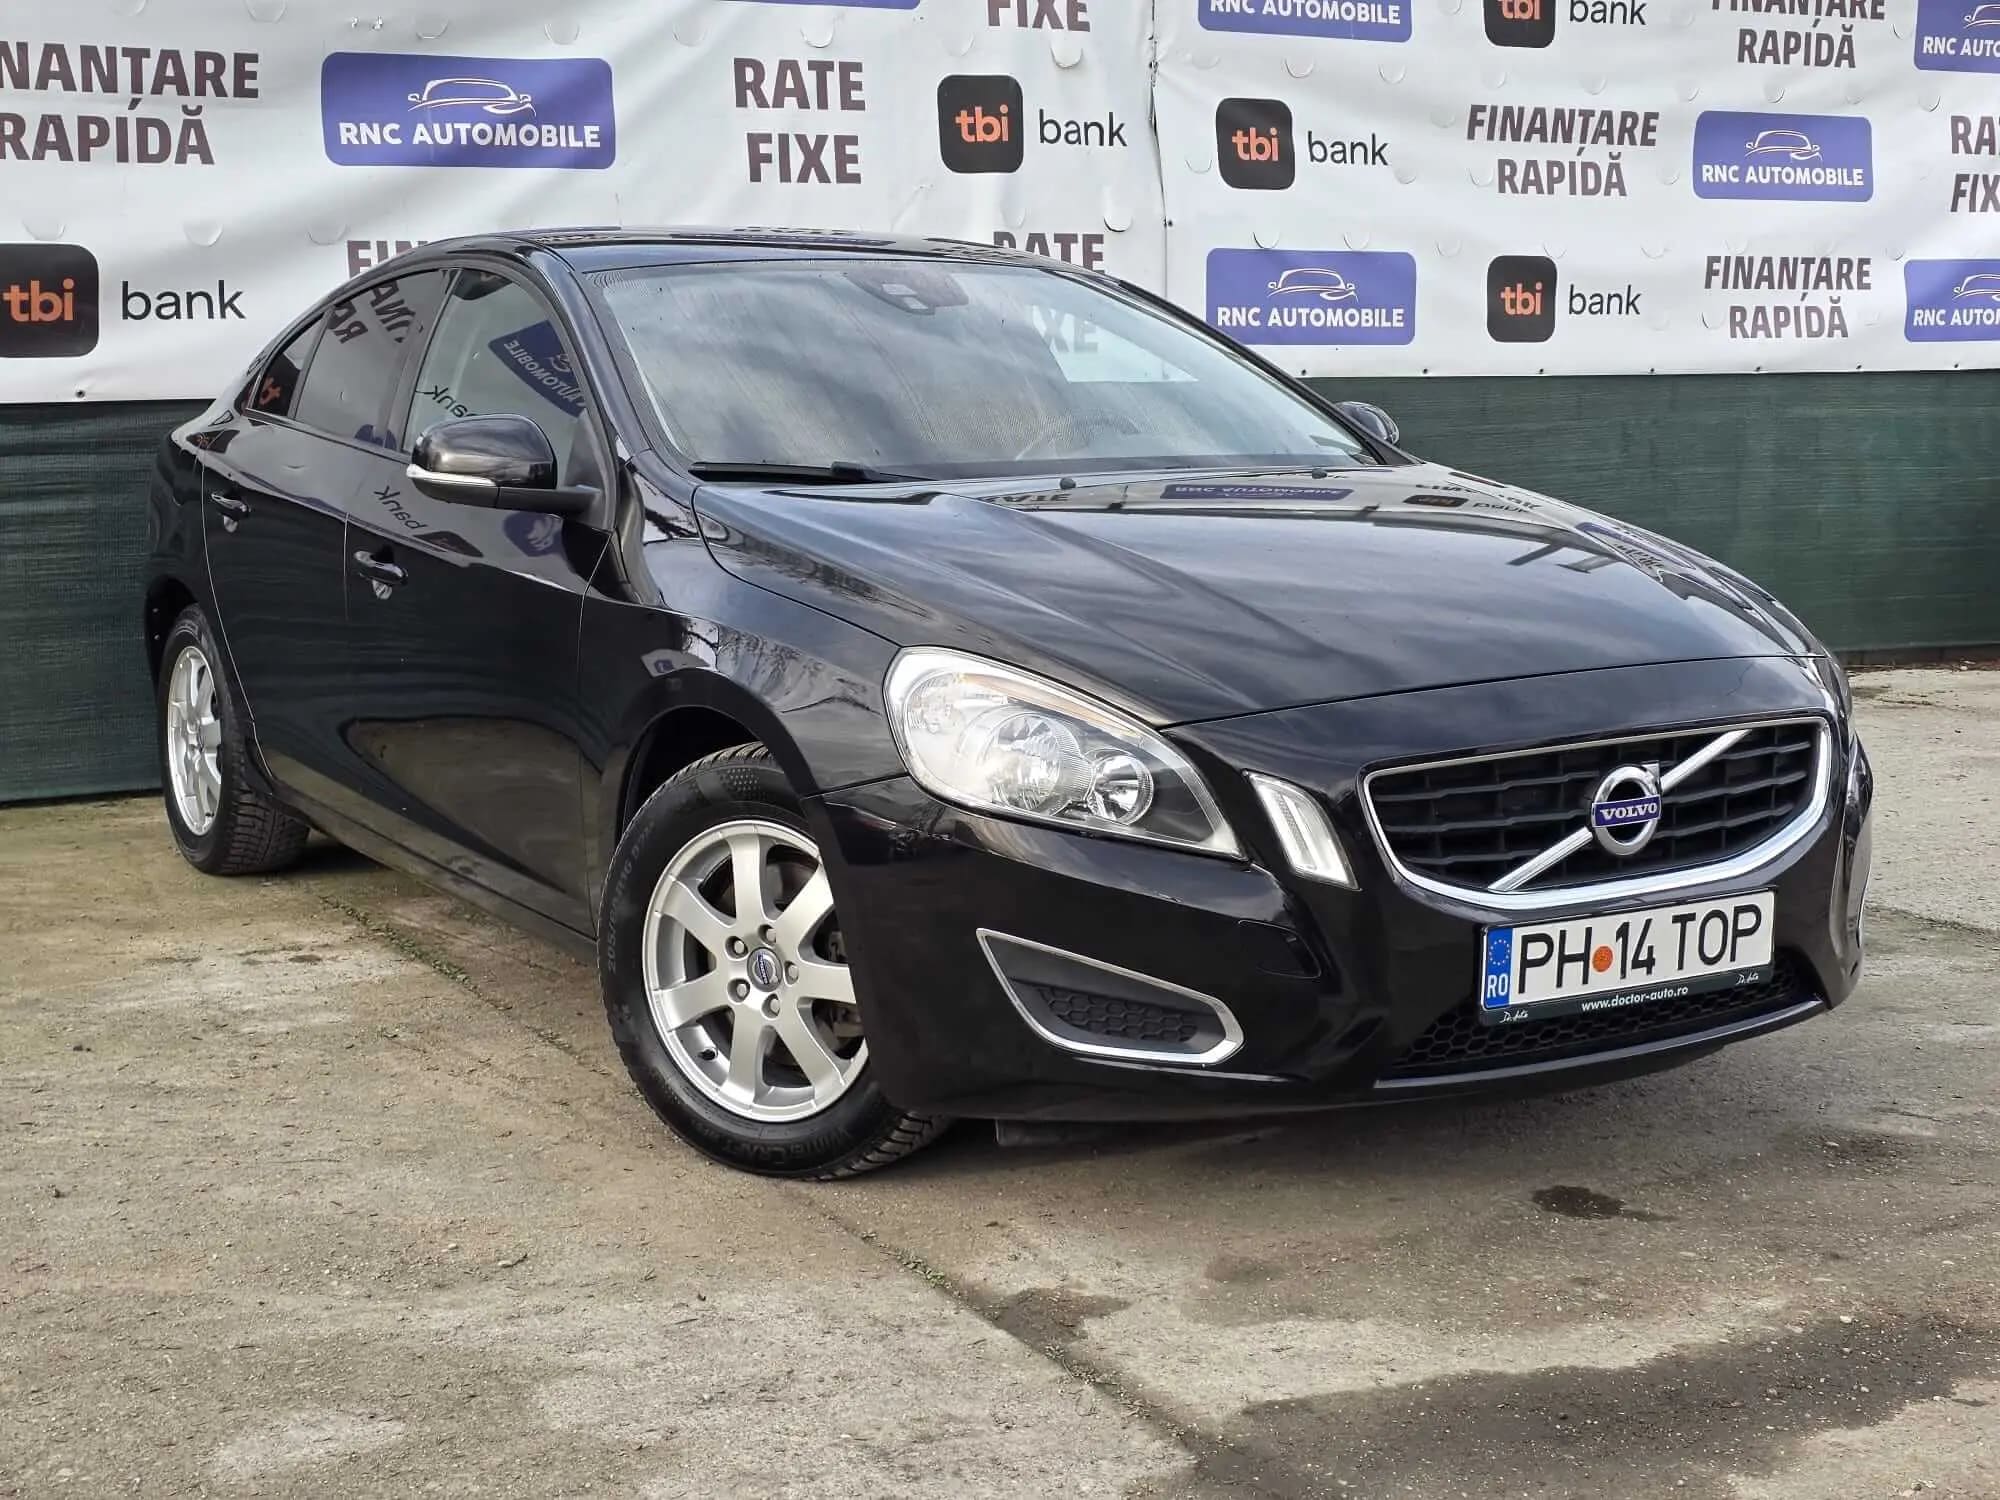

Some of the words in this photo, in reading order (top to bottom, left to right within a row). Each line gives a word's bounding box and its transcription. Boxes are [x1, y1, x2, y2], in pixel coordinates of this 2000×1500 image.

[1262, 0, 1400, 25] AUTOMOBILE
[1569, 0, 1646, 26] bank
[1737, 24, 1856, 69] RAPIDĂ
[1923, 36, 1957, 55] RNC
[1960, 39, 2000, 57] AUTO
[733, 57, 866, 111] RATE
[0, 104, 215, 165] RAPIDĂ
[339, 122, 402, 145] RNC
[412, 122, 601, 148] AUTOMOBILE
[956, 105, 1009, 144] tbi
[1039, 109, 1127, 147] bank
[1466, 104, 1660, 157] FINANȚARE
[1950, 115, 2000, 155] RA
[746, 133, 861, 184] FIXE
[1232, 127, 1279, 162] tbi
[1308, 130, 1389, 166] bank
[1497, 152, 1627, 197] RAPIDĂ
[1702, 164, 1739, 183] RNC
[1746, 166, 1864, 186] AUTOMOBILE
[1704, 256, 1872, 302] FINANȚARE
[3, 278, 74, 322] tbi
[121, 280, 246, 320] bank
[1217, 306, 1261, 327] RNC
[1268, 308, 1404, 328] AUTOMOBILE
[1501, 282, 1542, 316] tbi
[1568, 284, 1641, 316] bank
[1729, 296, 1849, 339] RAPIDĂ
[1913, 309, 1946, 326] RNC
[1950, 309, 2000, 326] AUTO
[1600, 803, 1657, 820] VOLVO
[1518, 926, 1593, 995] PH
[1615, 918, 1656, 980] 14
[1671, 903, 1762, 972] TOP
[1487, 974, 1509, 998] RO
[1581, 986, 1689, 1012] www.doctor-auto.ro
